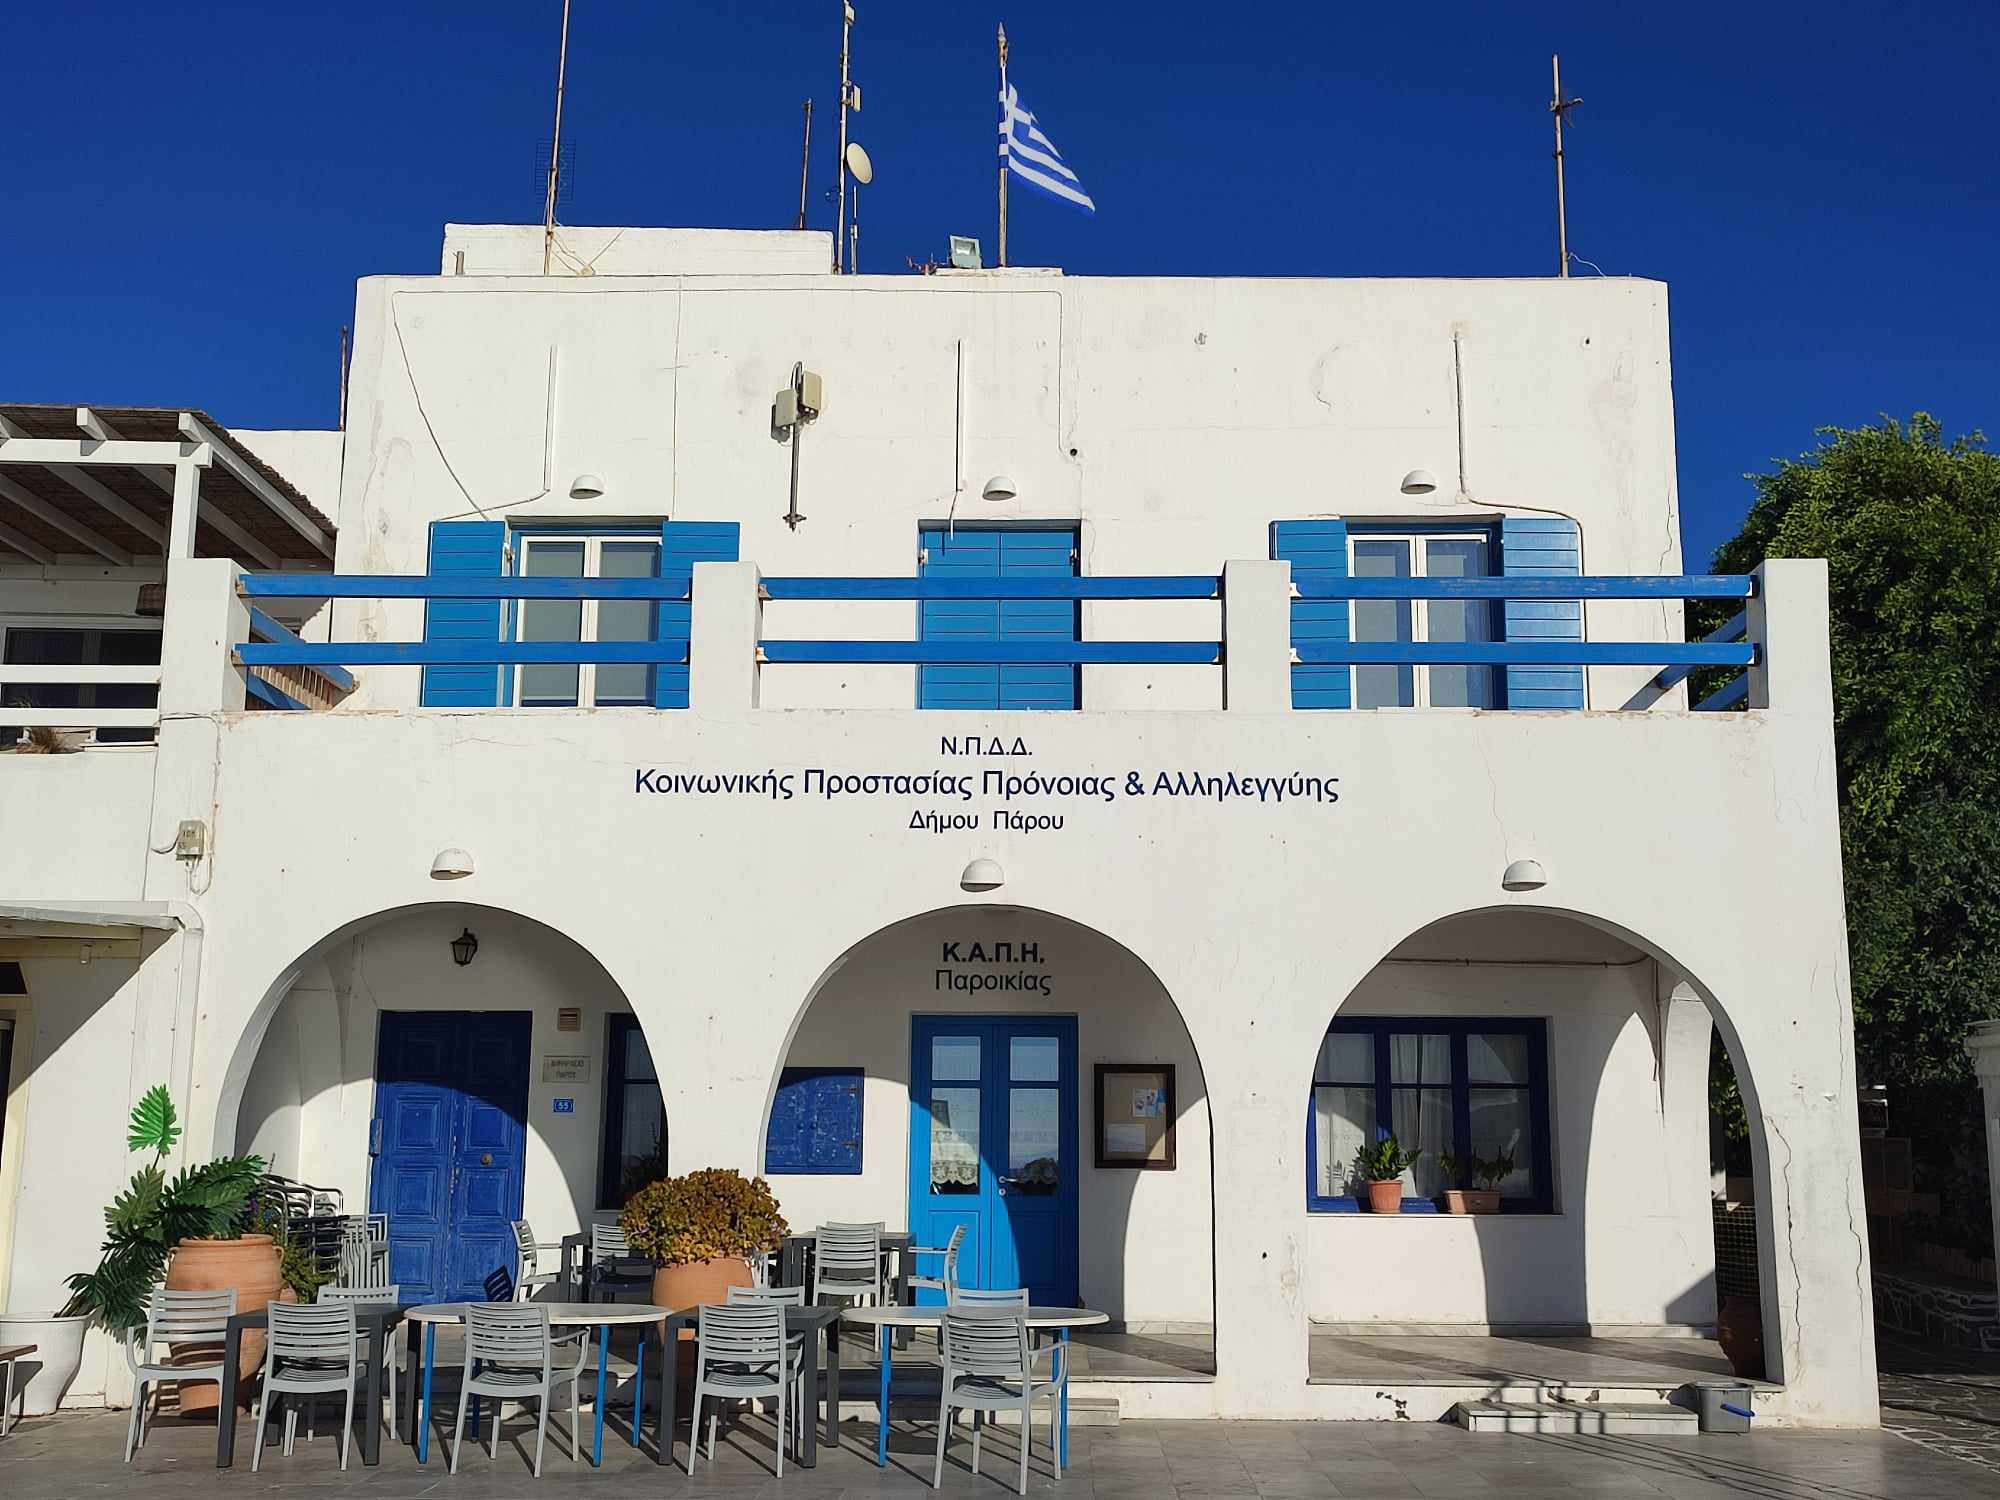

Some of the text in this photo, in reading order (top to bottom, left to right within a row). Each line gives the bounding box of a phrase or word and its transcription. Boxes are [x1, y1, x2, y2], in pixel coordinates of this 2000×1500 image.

[942, 736, 1033, 756] Ν.Π.Δ.Δ.
[636, 769, 1340, 804] Κοινωνικής Προστασίας Πρόνοιας & Αλληλεγγύης
[909, 809, 1064, 835] Δήμου Πάρου
[935, 969, 1052, 997] Παροικίας
